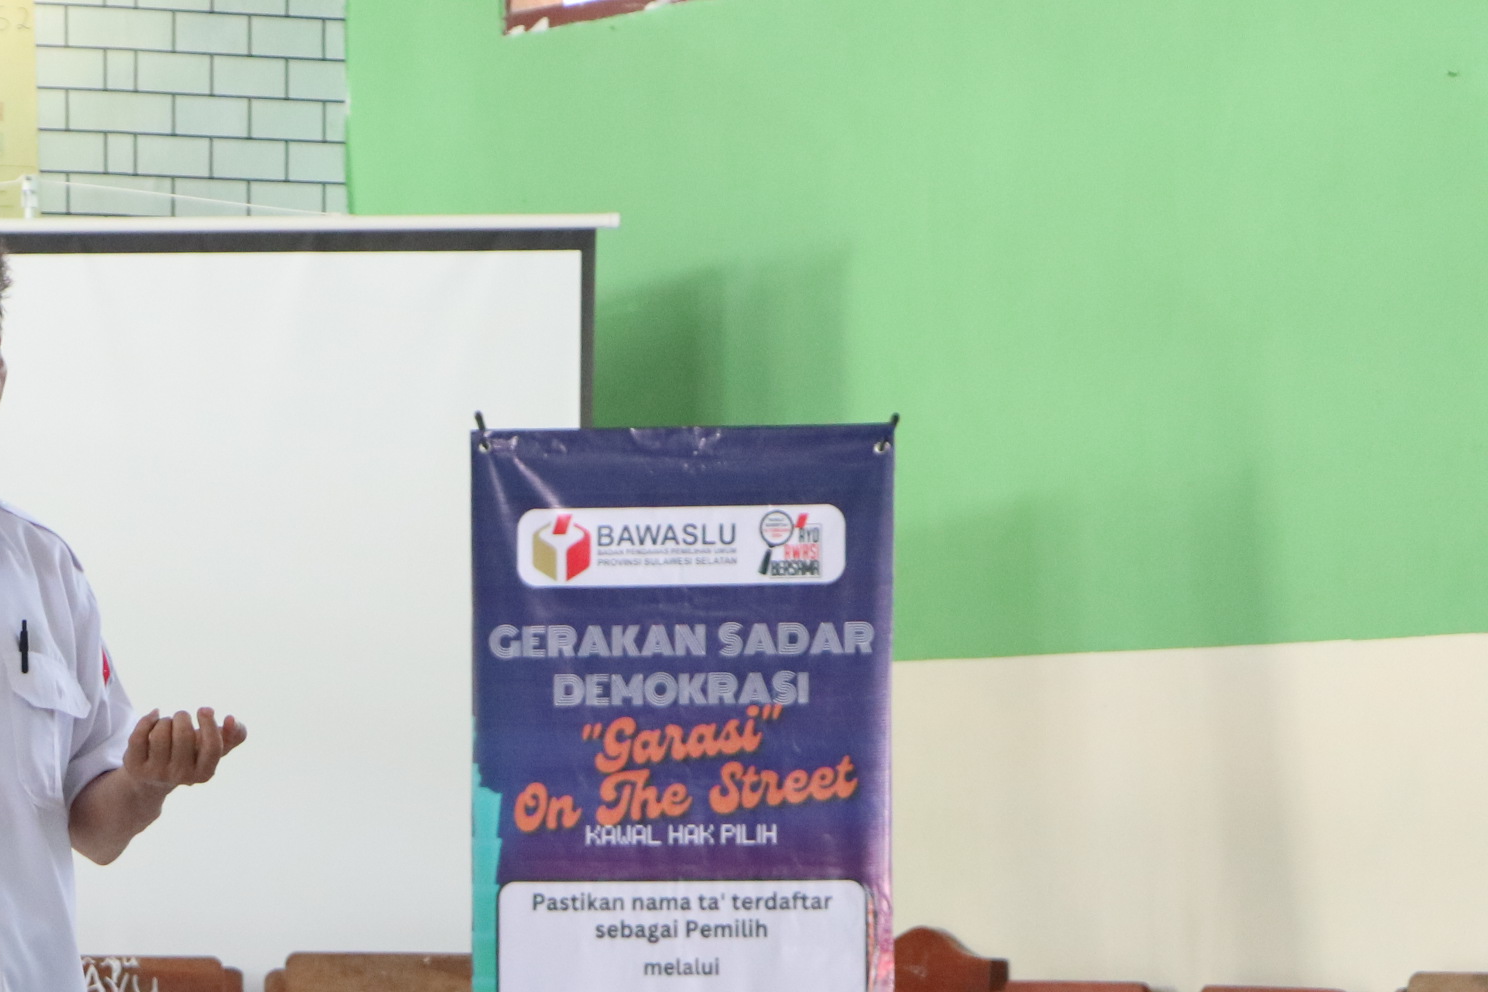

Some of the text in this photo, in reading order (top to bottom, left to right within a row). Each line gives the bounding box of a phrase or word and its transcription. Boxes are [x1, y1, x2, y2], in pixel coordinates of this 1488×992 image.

[597, 522, 737, 547] BAWASLU
[597, 556, 737, 567] PROVINSI SULAWESI SELATAN
[488, 620, 875, 660] GERAKAN SADAR
[553, 670, 810, 707] DEMOKRASI
[513, 755, 859, 833] On The Street
[584, 823, 778, 846] KAWAL HAK PILIH
[532, 891, 833, 912] Pastikan nama ta' terdaftar
[594, 919, 769, 943] sebagai Pemilih
[643, 957, 720, 976] melalui
